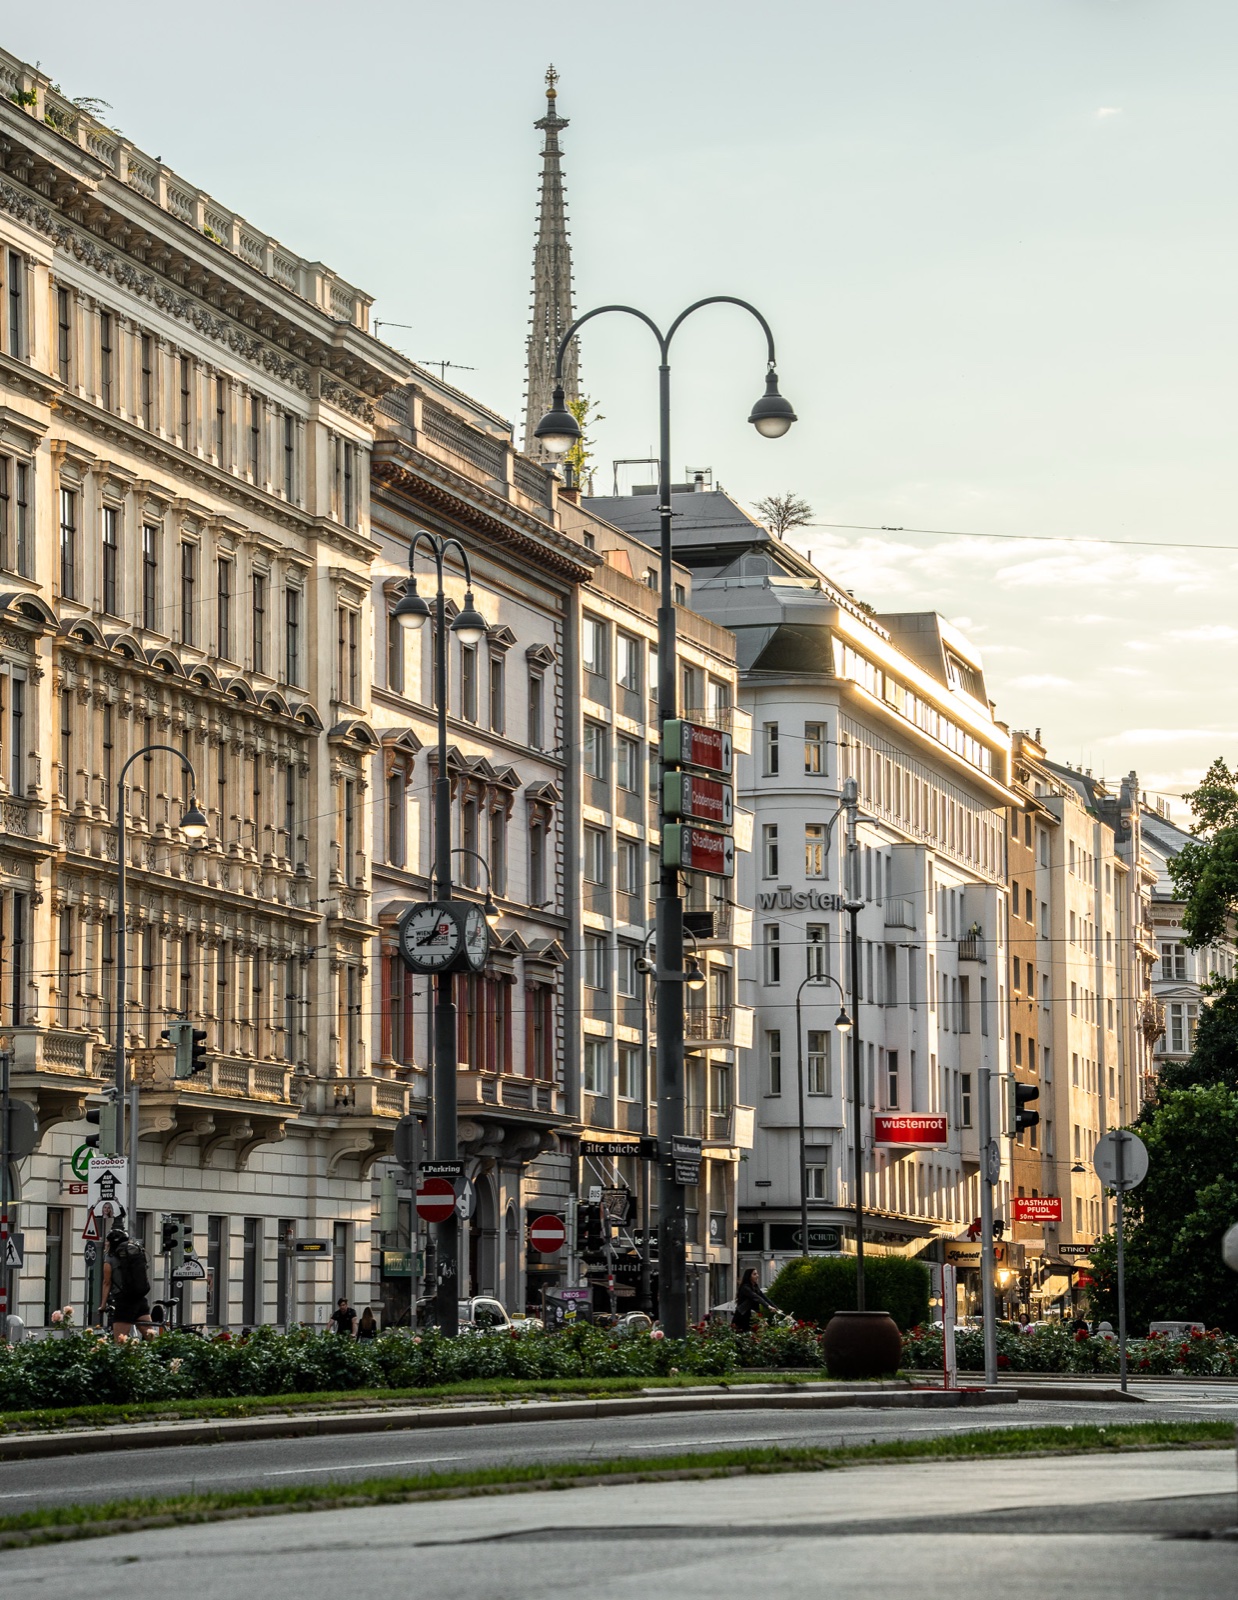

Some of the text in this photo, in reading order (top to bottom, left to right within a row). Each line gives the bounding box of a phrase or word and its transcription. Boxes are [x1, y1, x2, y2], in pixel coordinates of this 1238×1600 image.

[692, 831, 724, 853] Stadtpark
[608, 1143, 640, 1155] büche
[590, 1190, 601, 1198] BUS
[798, 1233, 837, 1241] PACHUTT
